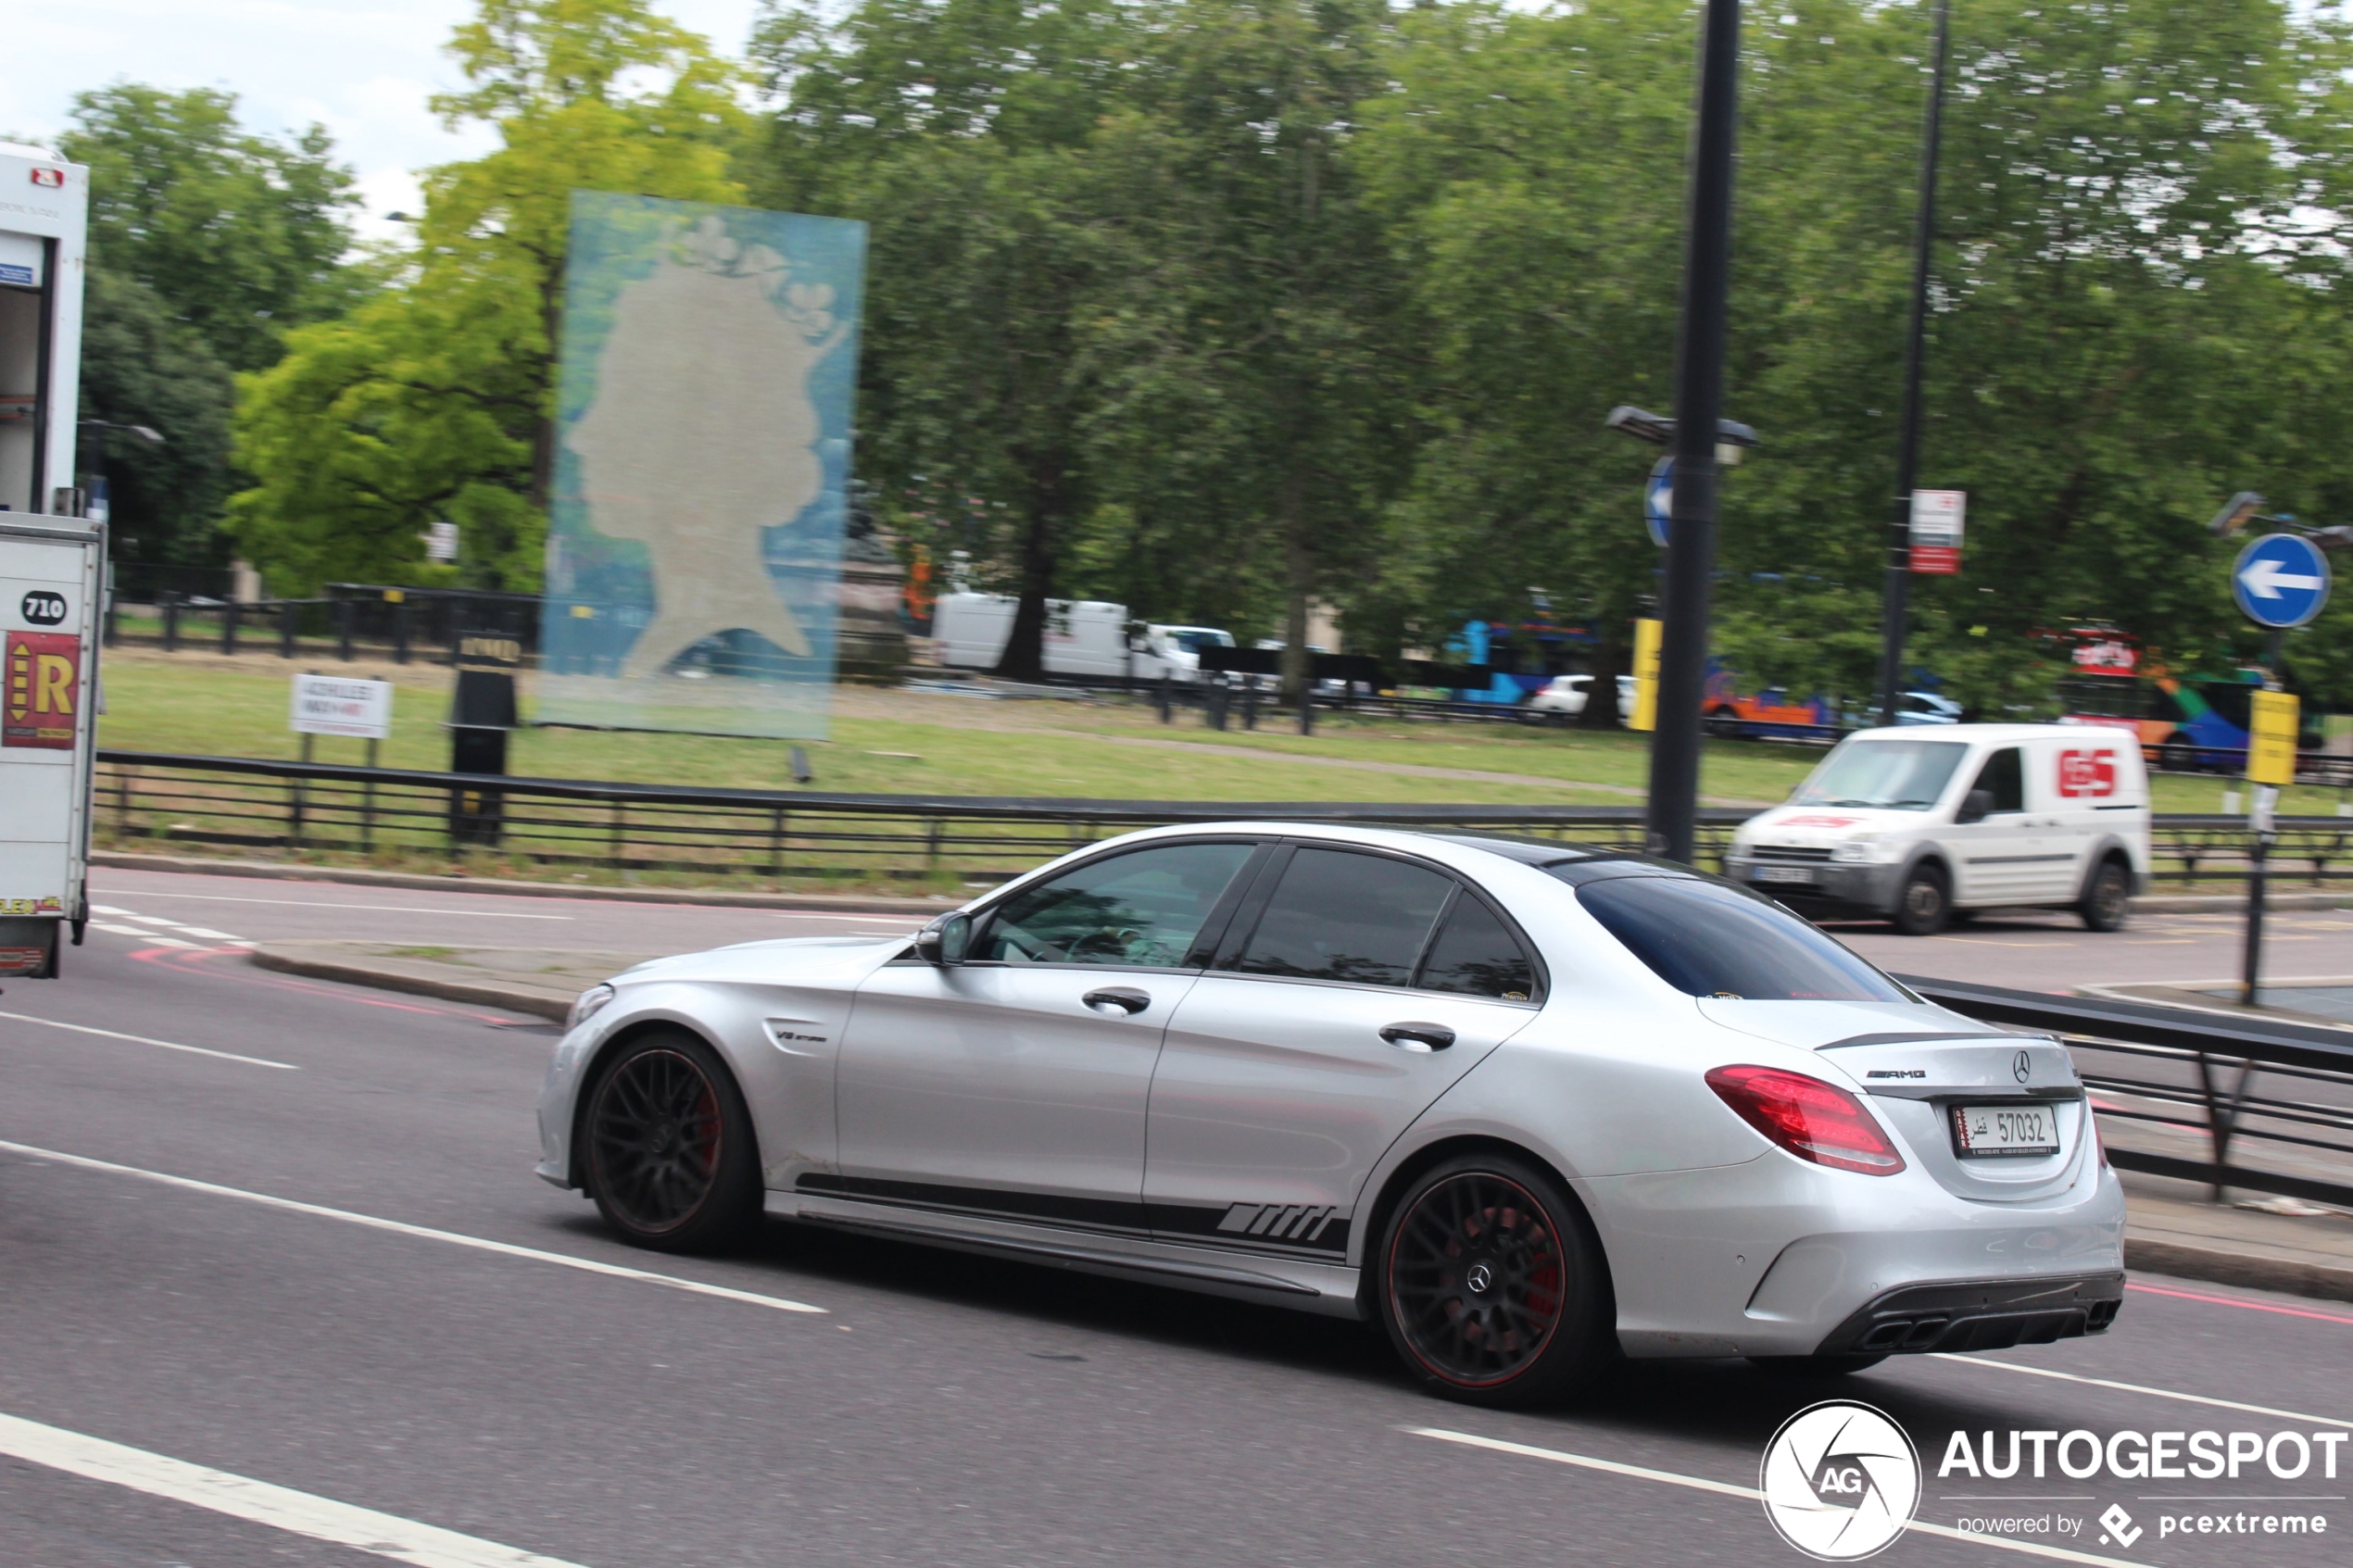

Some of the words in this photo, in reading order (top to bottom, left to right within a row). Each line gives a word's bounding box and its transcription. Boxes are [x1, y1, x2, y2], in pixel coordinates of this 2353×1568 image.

[25, 597, 65, 619] 710
[35, 654, 75, 715] R
[1886, 1070, 1927, 1078] AMG
[1956, 1110, 1967, 1148] QATAR
[1969, 1116, 1988, 1140] قطر
[1996, 1112, 2045, 1142] 57032
